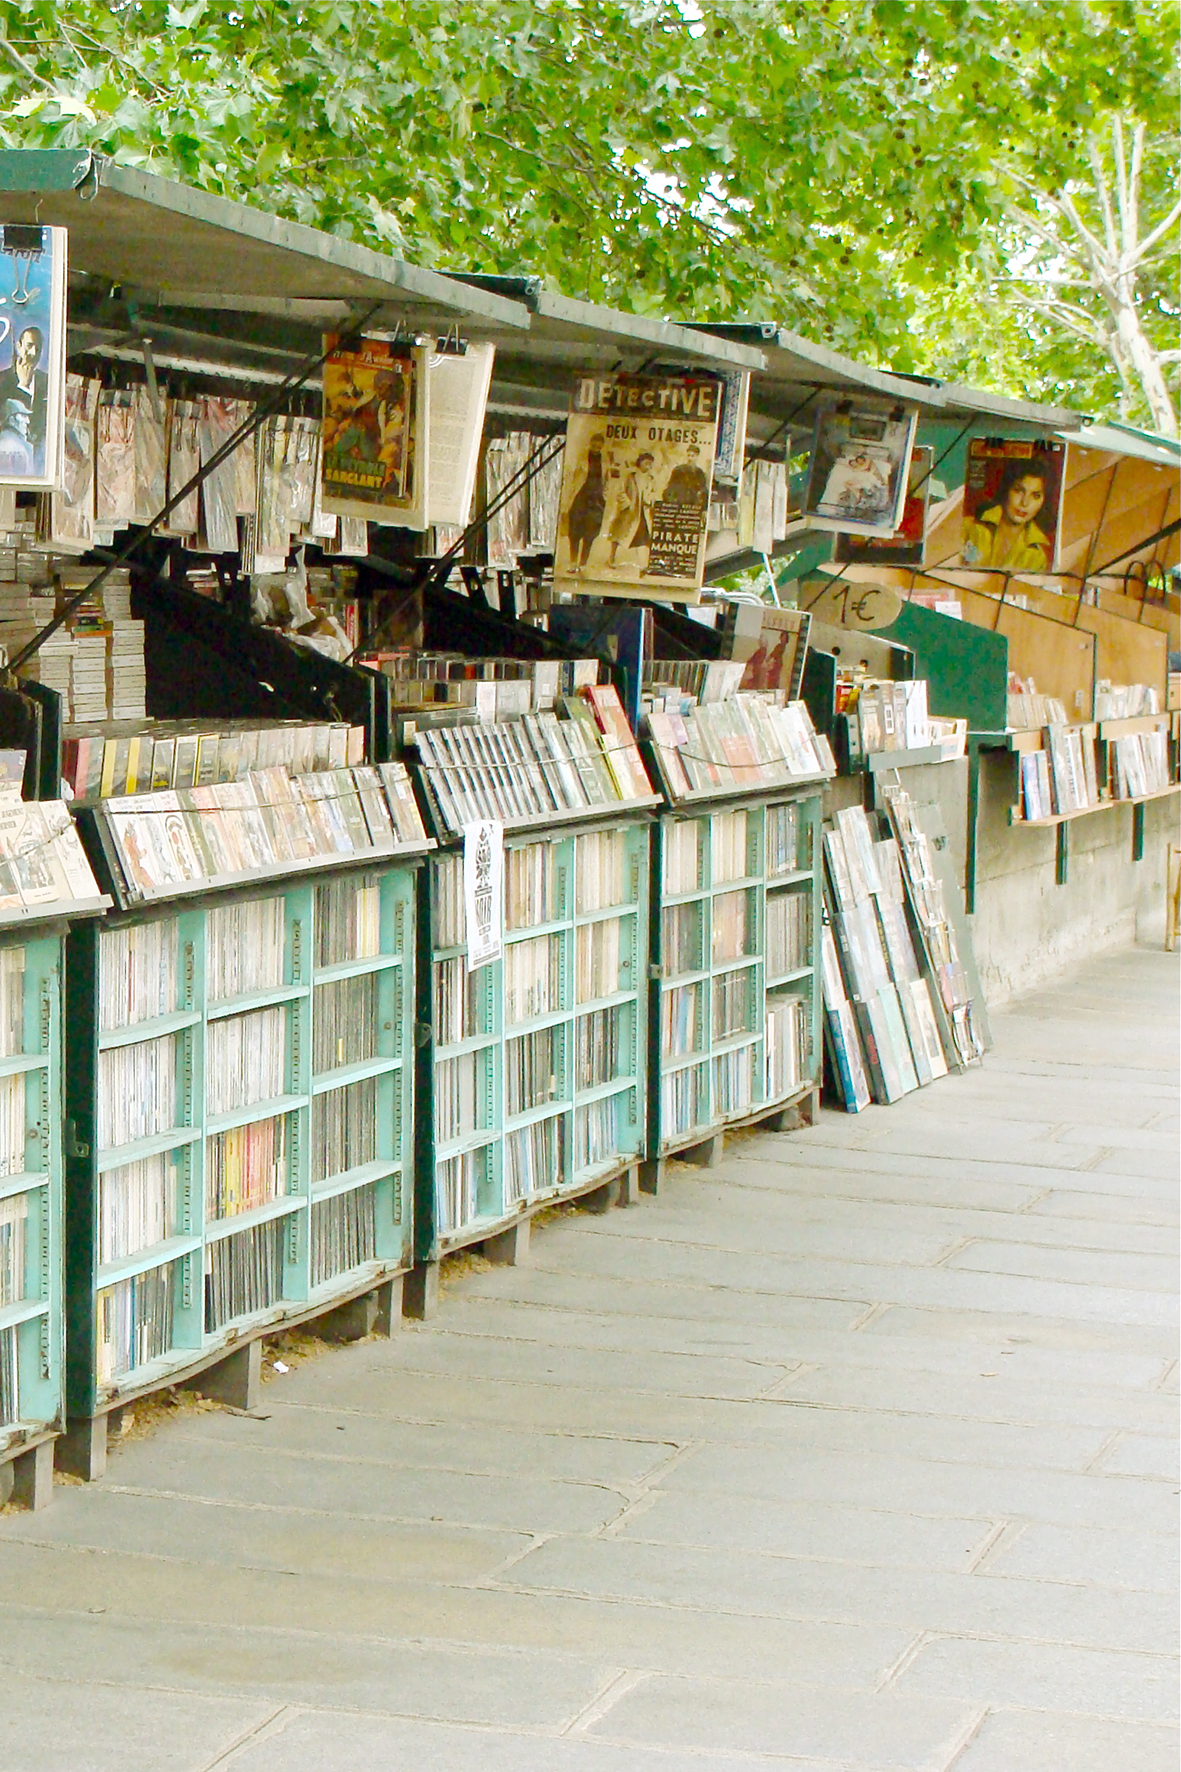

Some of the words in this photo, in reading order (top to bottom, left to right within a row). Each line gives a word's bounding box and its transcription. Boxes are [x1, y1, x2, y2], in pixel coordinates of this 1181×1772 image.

[579, 378, 713, 417] DETECTIVE
[606, 424, 637, 439] DEUX
[648, 427, 712, 445] OTAGES...
[652, 531, 699, 543] PIRATE
[833, 585, 881, 624] 1€
